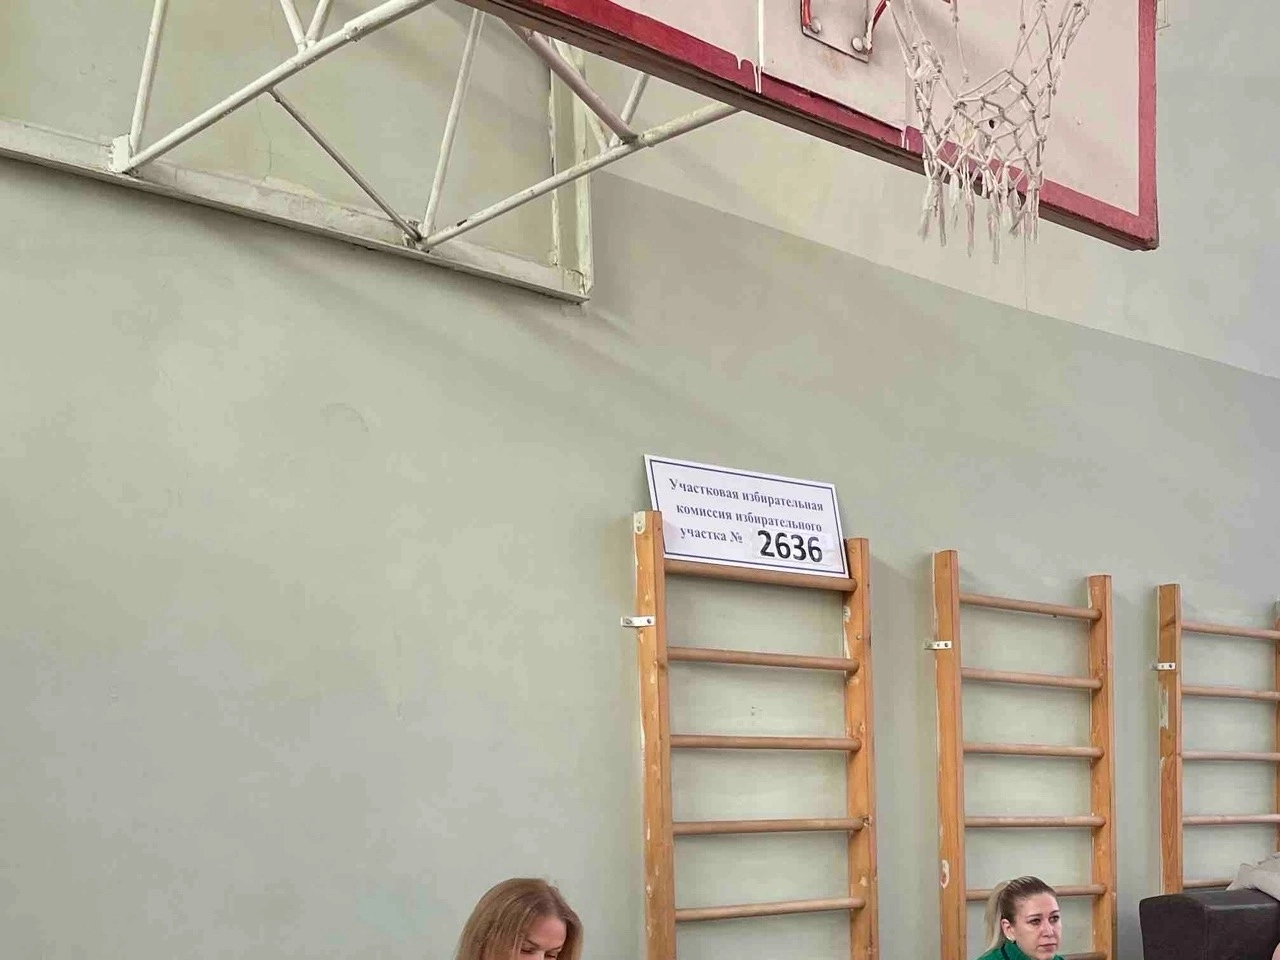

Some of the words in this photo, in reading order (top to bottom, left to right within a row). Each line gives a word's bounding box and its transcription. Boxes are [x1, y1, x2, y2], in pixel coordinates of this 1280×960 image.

[669, 478, 739, 499] Участковая
[742, 491, 824, 511] избирательная
[676, 505, 732, 520] комиссия
[736, 511, 822, 532] избирательного
[680, 527, 727, 542] участка
[730, 531, 743, 544] №
[757, 530, 823, 563] 2636
